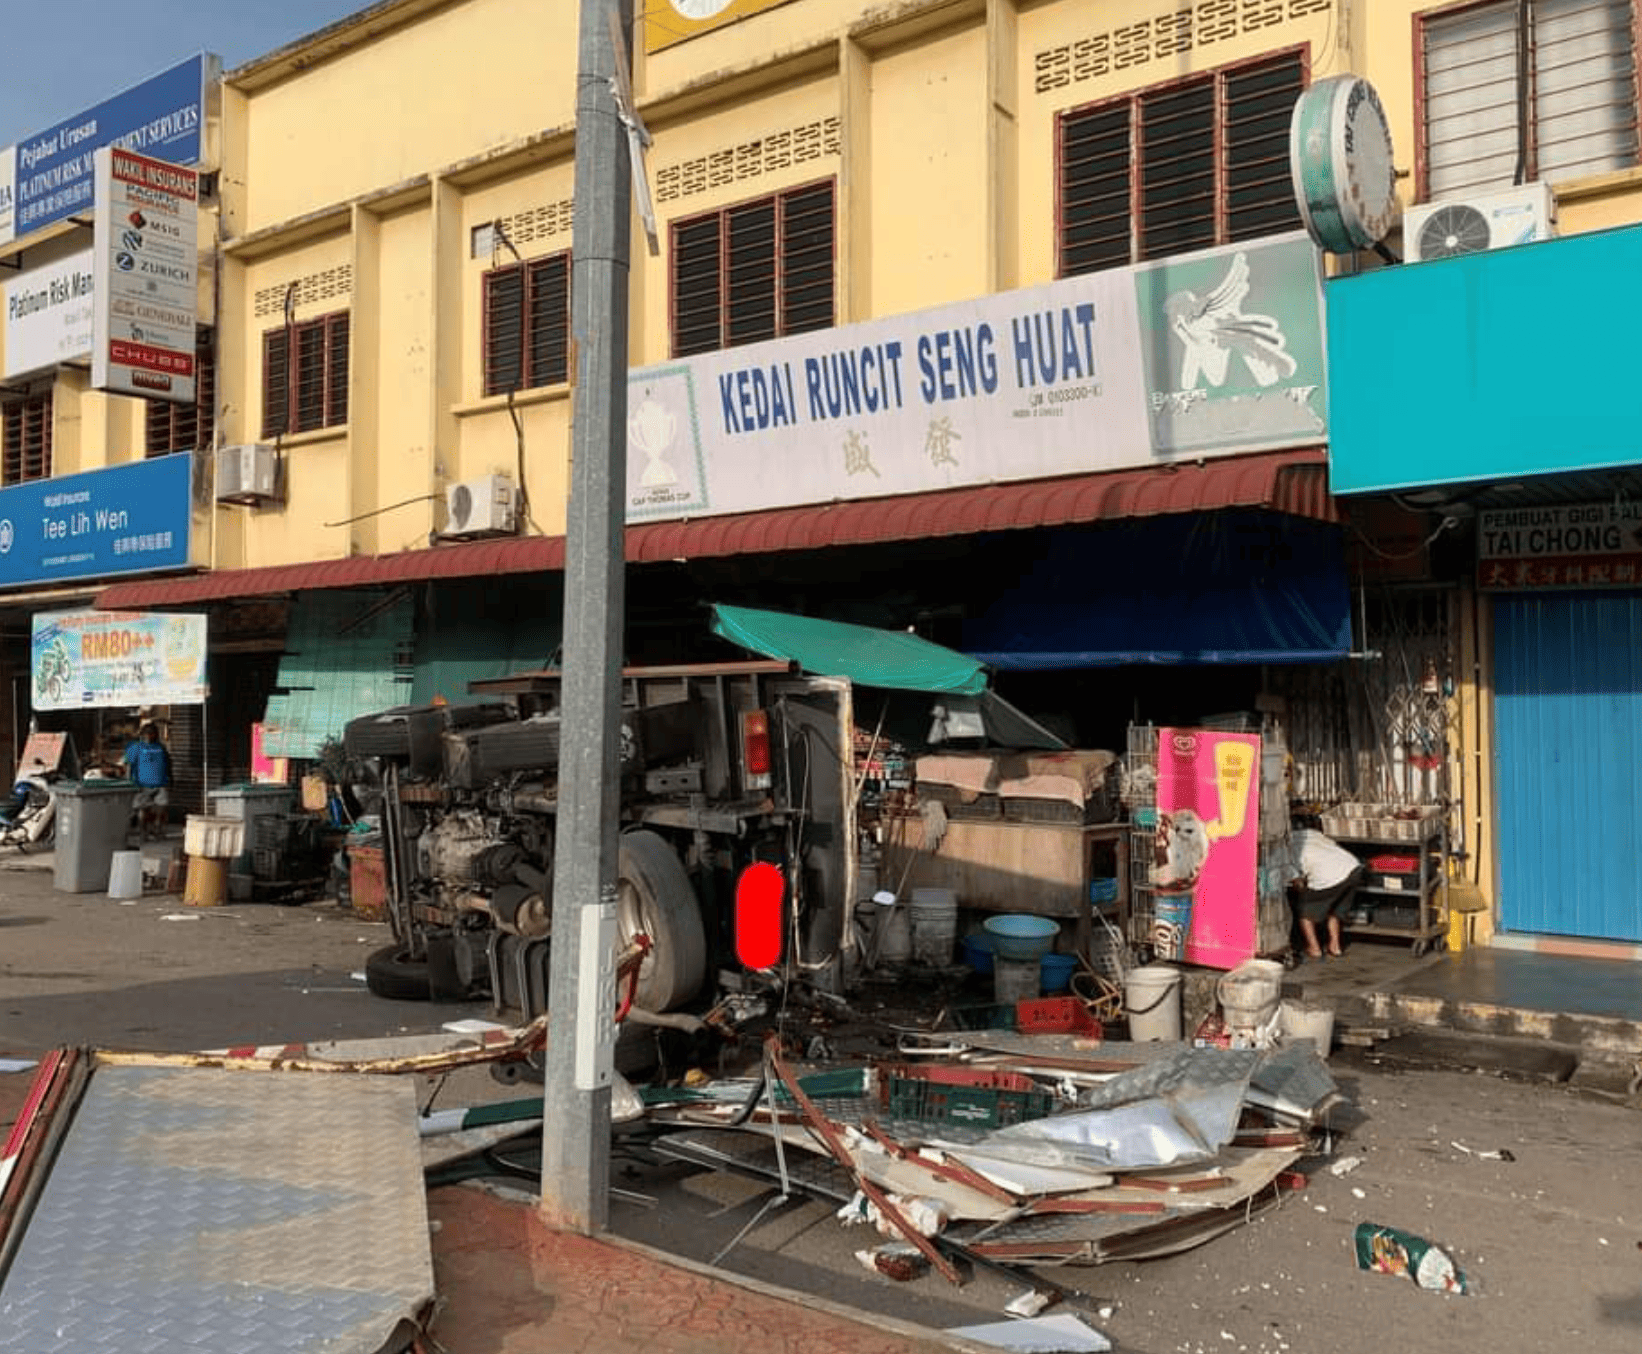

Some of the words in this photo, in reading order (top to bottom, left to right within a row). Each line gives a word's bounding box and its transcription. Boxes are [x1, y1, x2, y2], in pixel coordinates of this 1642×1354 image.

[150, 220, 180, 237] MSIG
[140, 261, 189, 282] ZURICH
[50, 276, 70, 306] Risk
[72, 271, 94, 299] Man
[112, 346, 188, 369] CHUBB
[719, 362, 796, 435] KEDAI
[804, 341, 902, 422] RUNCIT
[917, 322, 998, 404] SENG
[1012, 303, 1095, 389] HUAT
[42, 517, 67, 539] Tee
[95, 508, 128, 531] Wen
[1484, 509, 1562, 527] PEMBUAT
[1568, 507, 1604, 523] GIGI
[1485, 531, 1521, 555] TAI
[1529, 526, 1622, 553] CHONG
